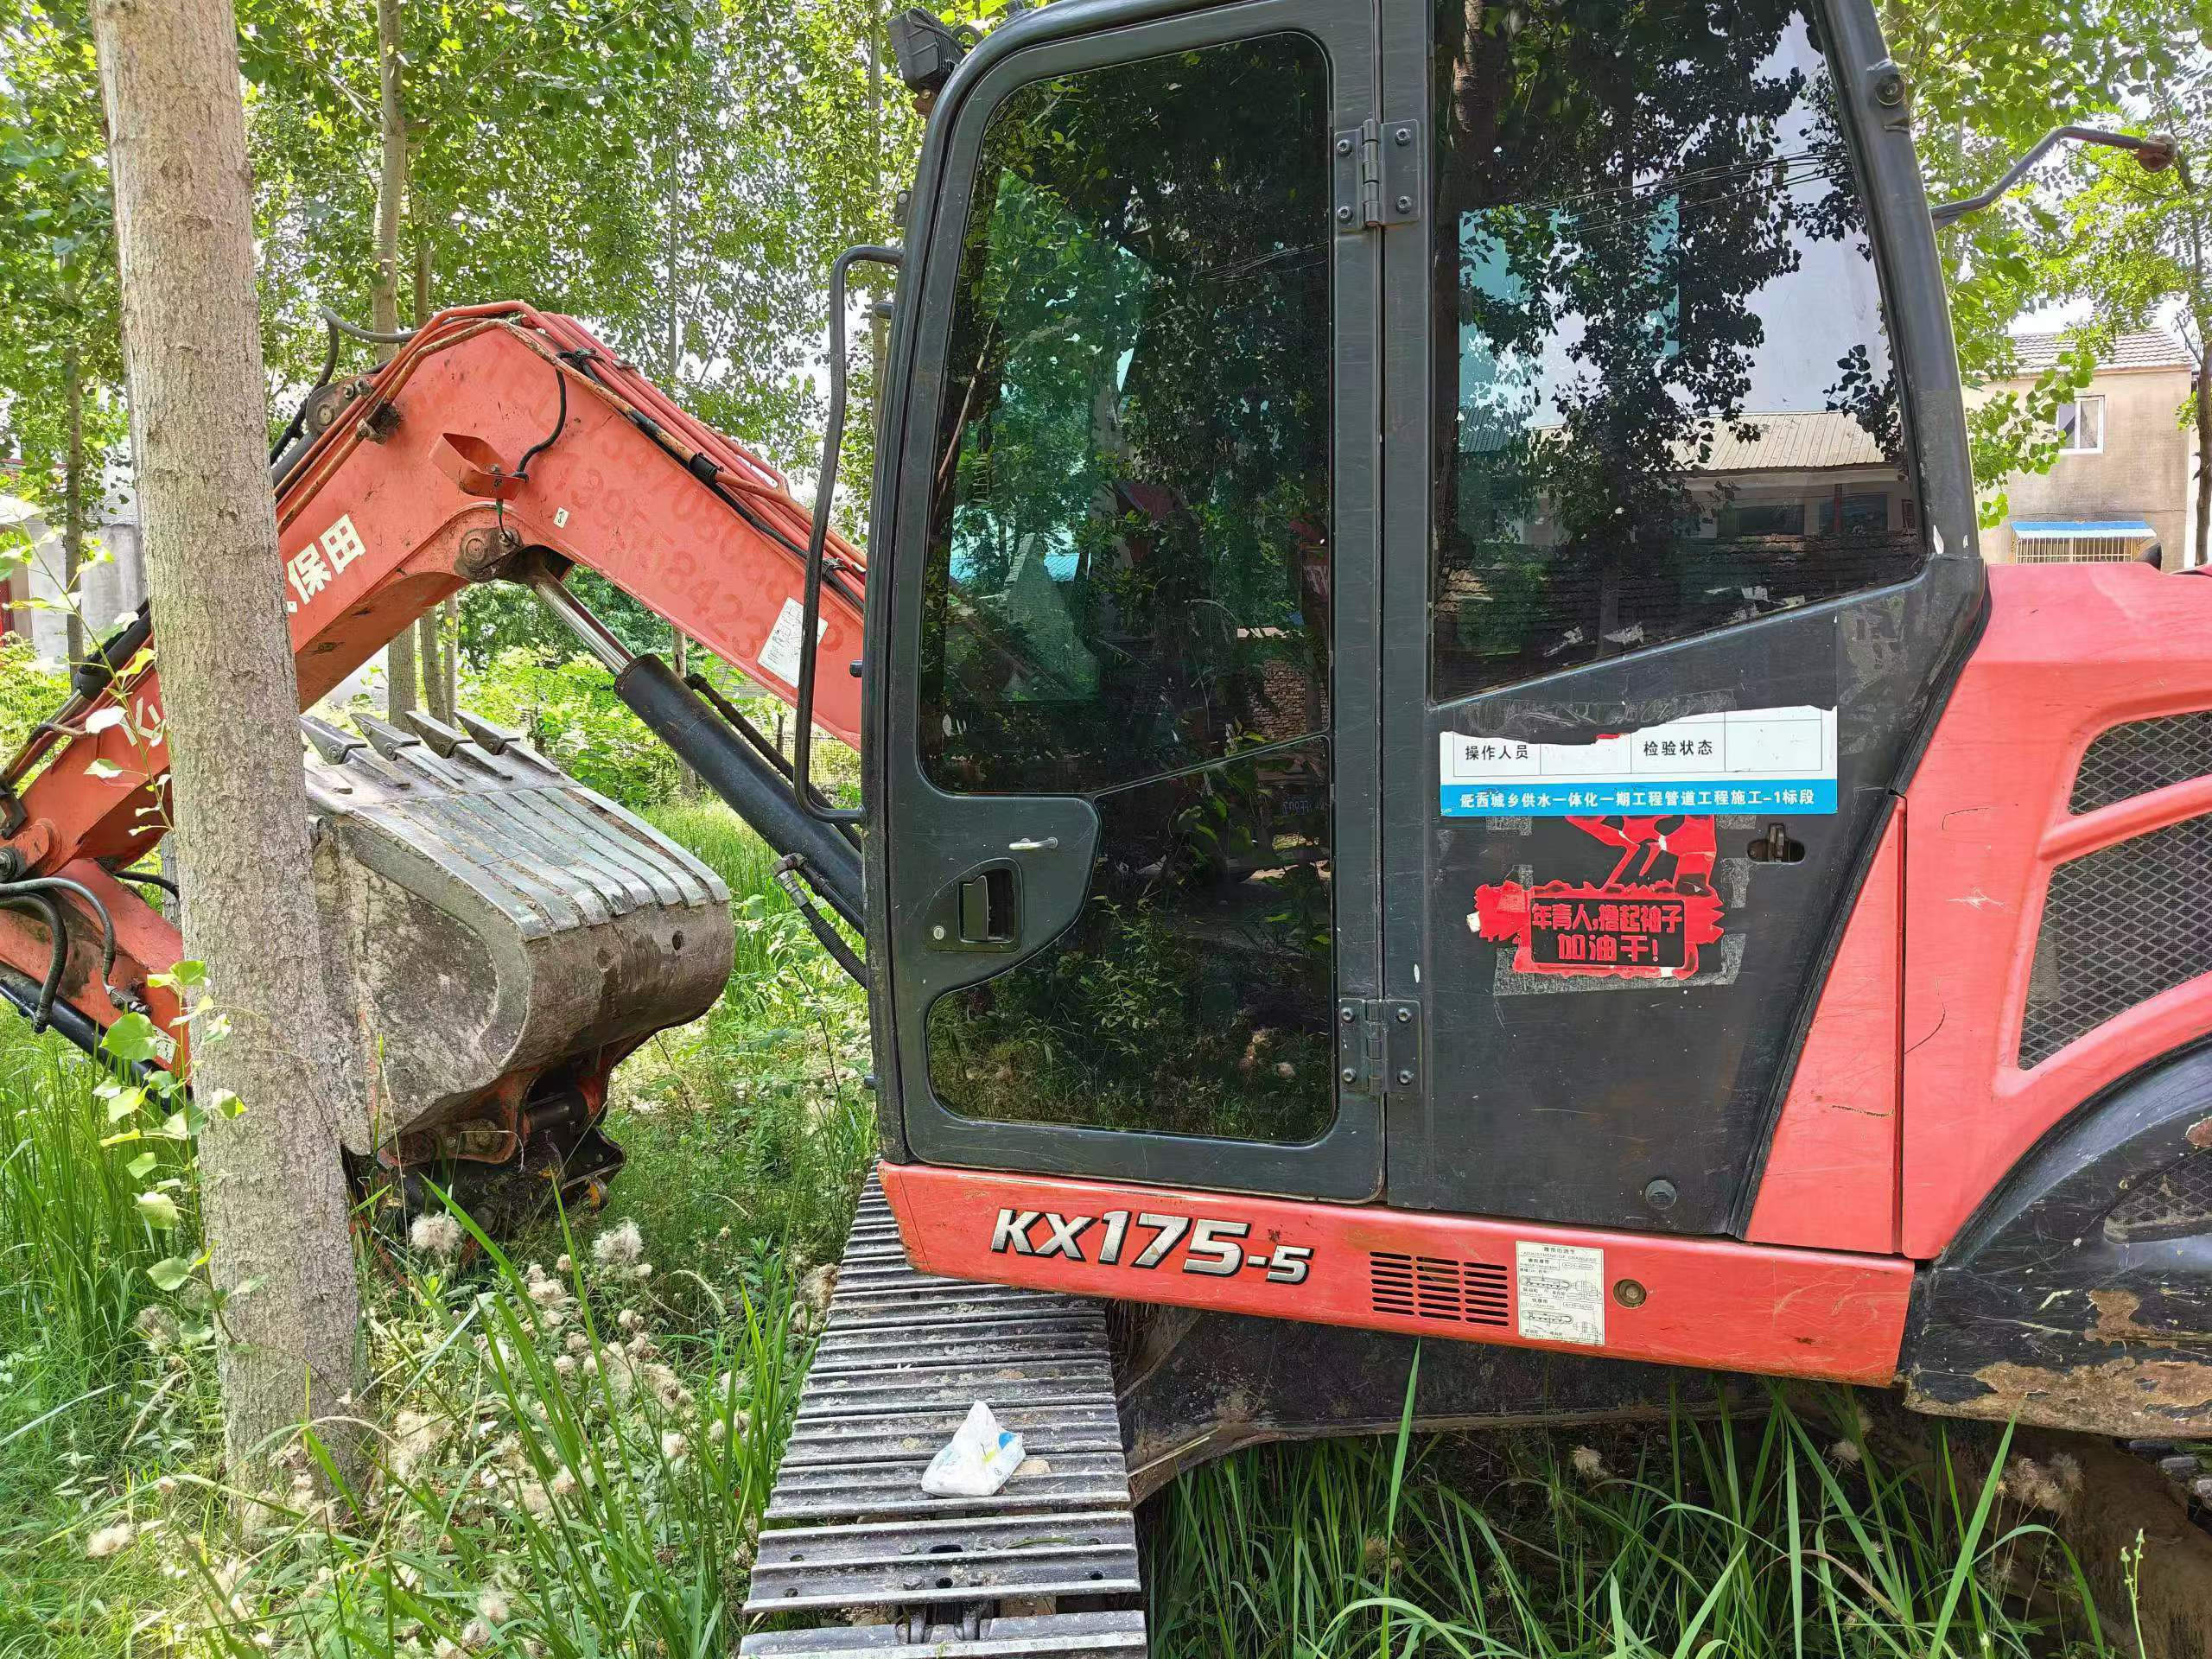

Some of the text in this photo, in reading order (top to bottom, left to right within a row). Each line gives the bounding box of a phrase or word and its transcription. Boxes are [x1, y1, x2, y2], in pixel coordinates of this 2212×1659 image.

[287, 513, 366, 613] 保田
[1465, 745, 1529, 761] 操作人员
[1643, 739, 1713, 757] 检验状态
[991, 1207, 1313, 1286] KX175-5
